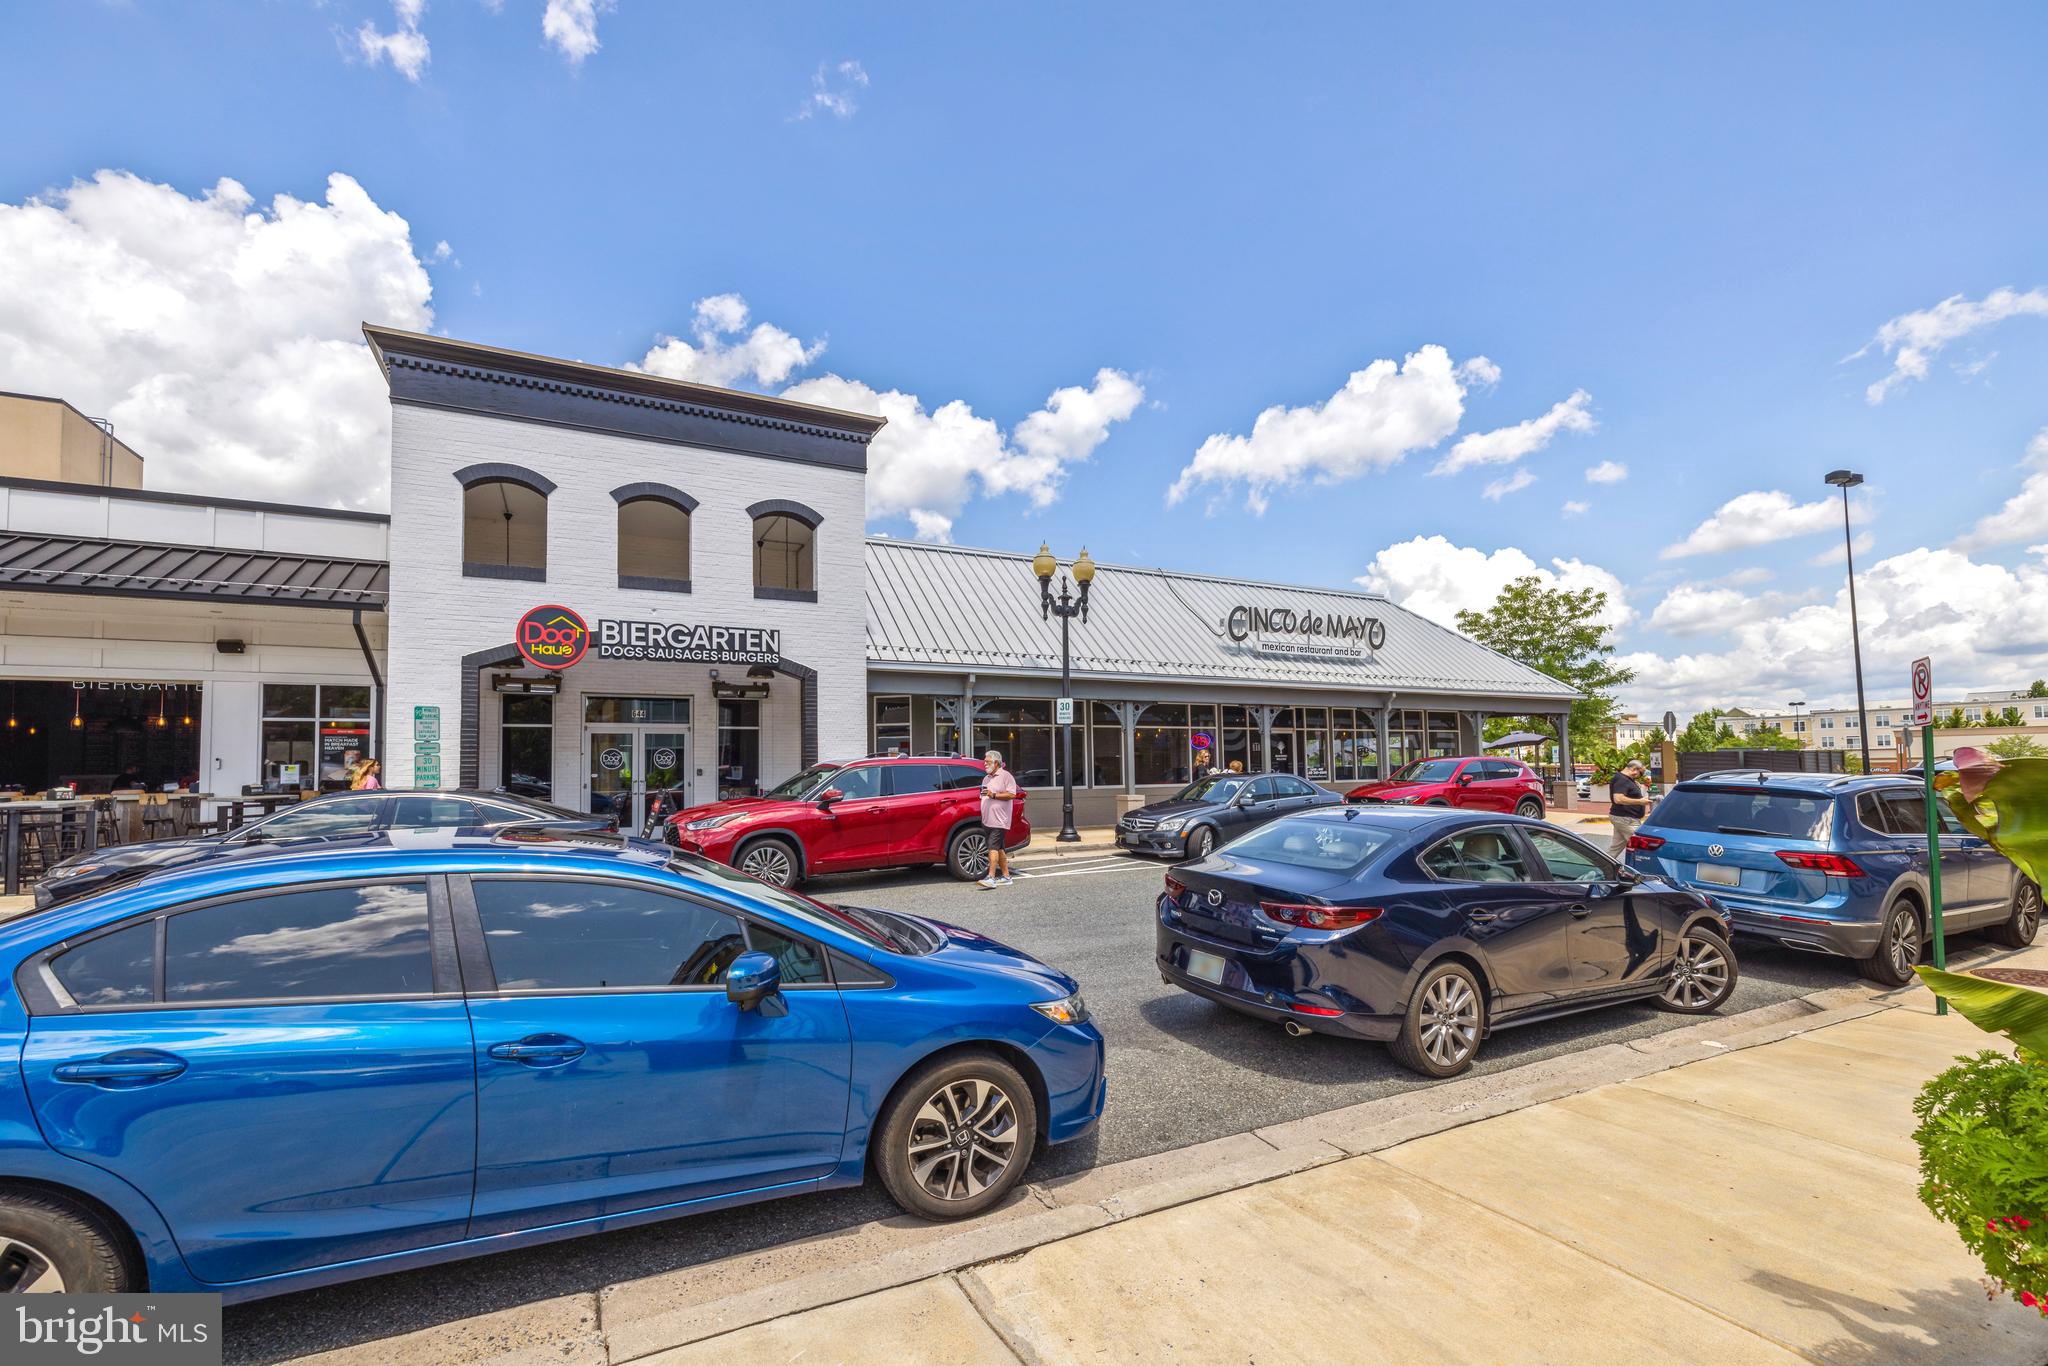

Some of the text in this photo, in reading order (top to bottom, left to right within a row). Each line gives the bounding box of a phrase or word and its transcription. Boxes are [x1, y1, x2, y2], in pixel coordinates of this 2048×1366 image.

[1228, 606, 1386, 650] CINCO de MAYO
[524, 621, 577, 658] Dog
[601, 620, 780, 652] BIERGARTEN
[531, 643, 574, 656] Haus
[1262, 643, 1362, 657] mexican restaurant and bar
[1060, 702, 1070, 711] 30
[632, 710, 646, 718] 644
[423, 757, 433, 765] 30
[416, 765, 439, 773] MINUTE
